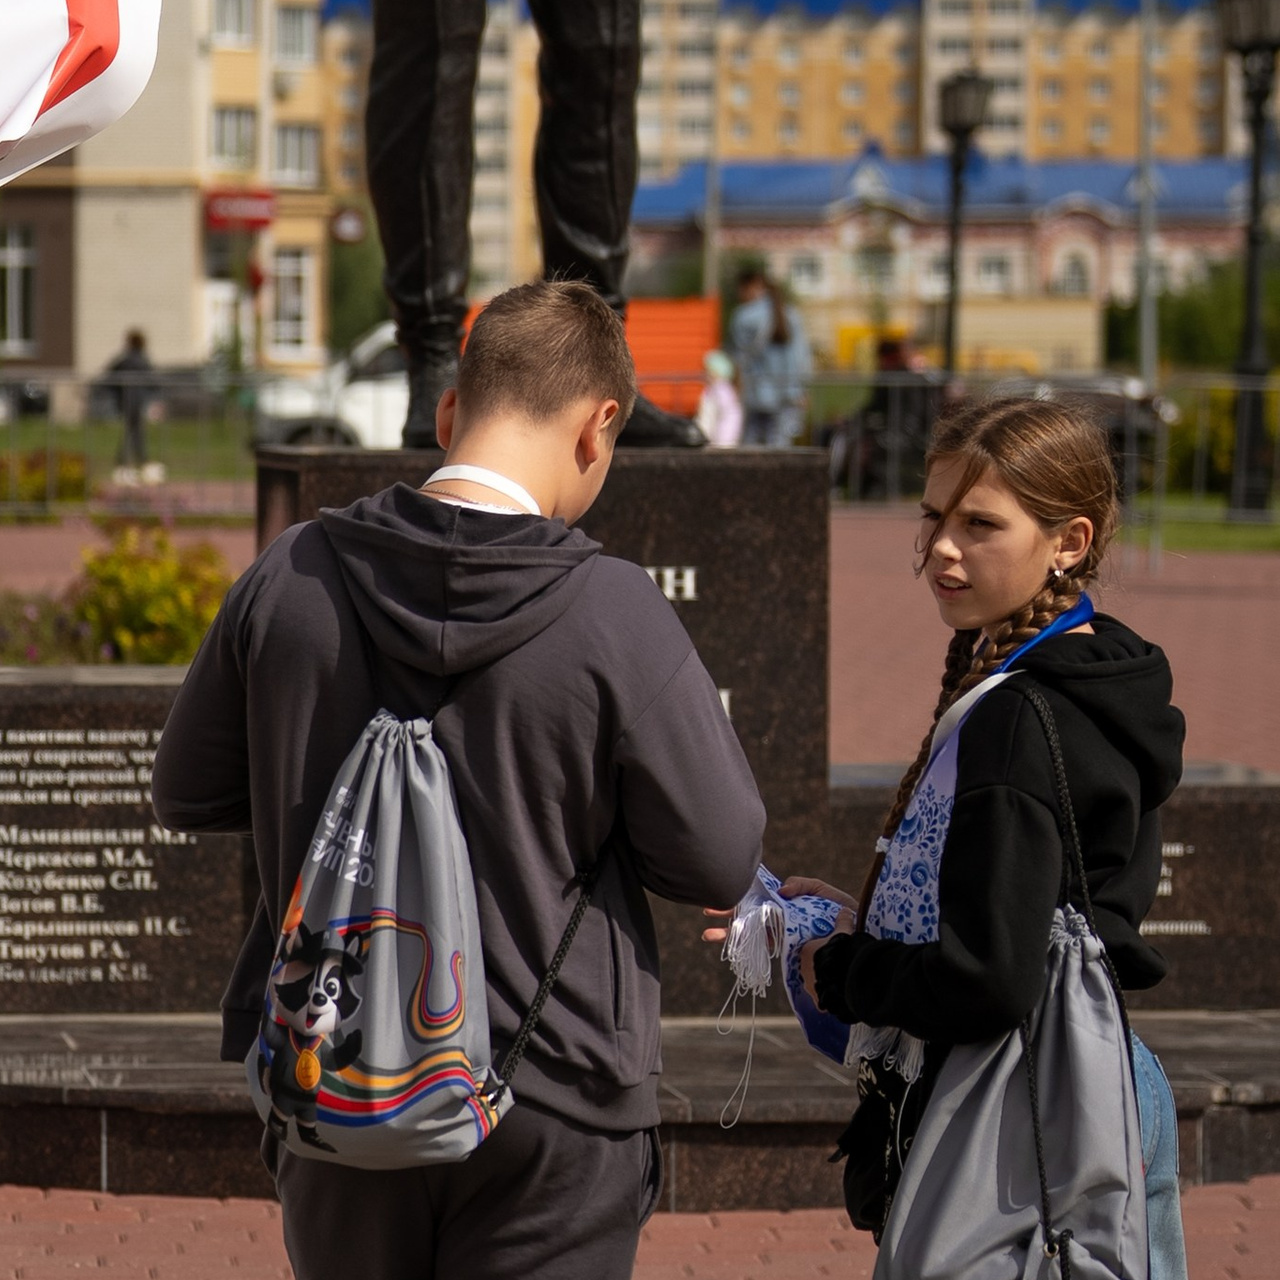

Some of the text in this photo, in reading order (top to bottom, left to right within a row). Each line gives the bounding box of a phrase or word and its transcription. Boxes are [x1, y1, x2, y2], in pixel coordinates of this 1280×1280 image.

[6, 729, 85, 745] памятник
[87, 729, 149, 747] нашему
[19, 768, 135, 788] греко-римской
[51, 790, 71, 805] на
[73, 790, 142, 808] средства
[102, 847, 154, 868] М.А.
[109, 870, 158, 891] С.П.
[89, 939, 130, 960] Р.А.
